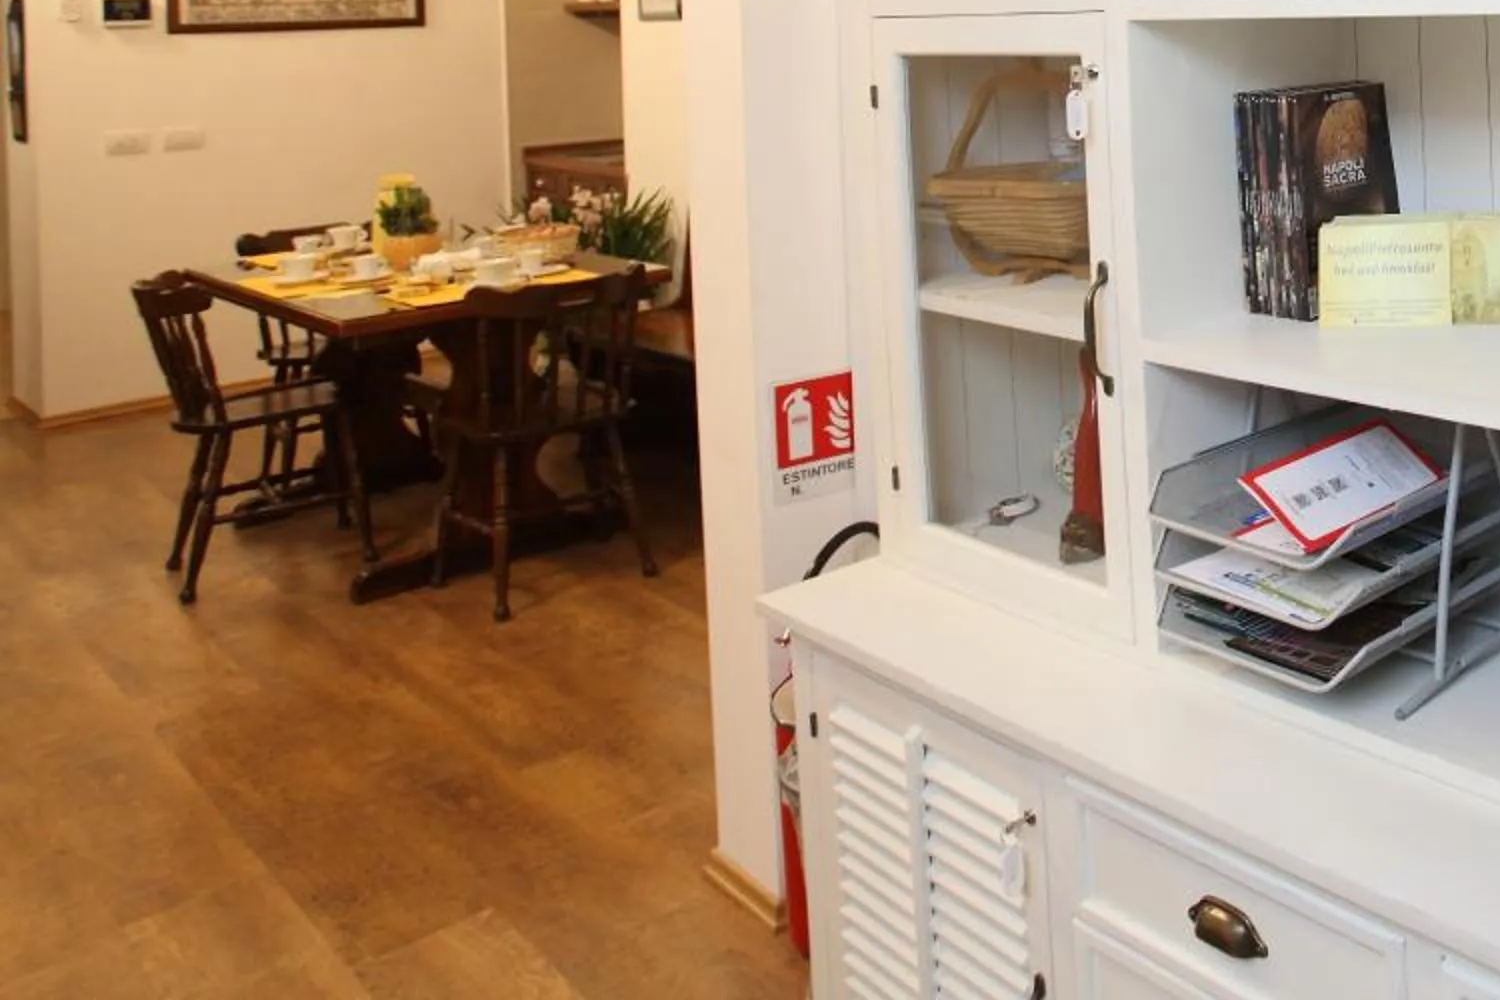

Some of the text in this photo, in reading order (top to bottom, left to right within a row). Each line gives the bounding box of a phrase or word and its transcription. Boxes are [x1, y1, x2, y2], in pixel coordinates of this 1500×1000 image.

[1323, 157, 1366, 175] NAPOLI
[1323, 171, 1367, 188] SACRA
[783, 457, 855, 486] ESTINTORE
